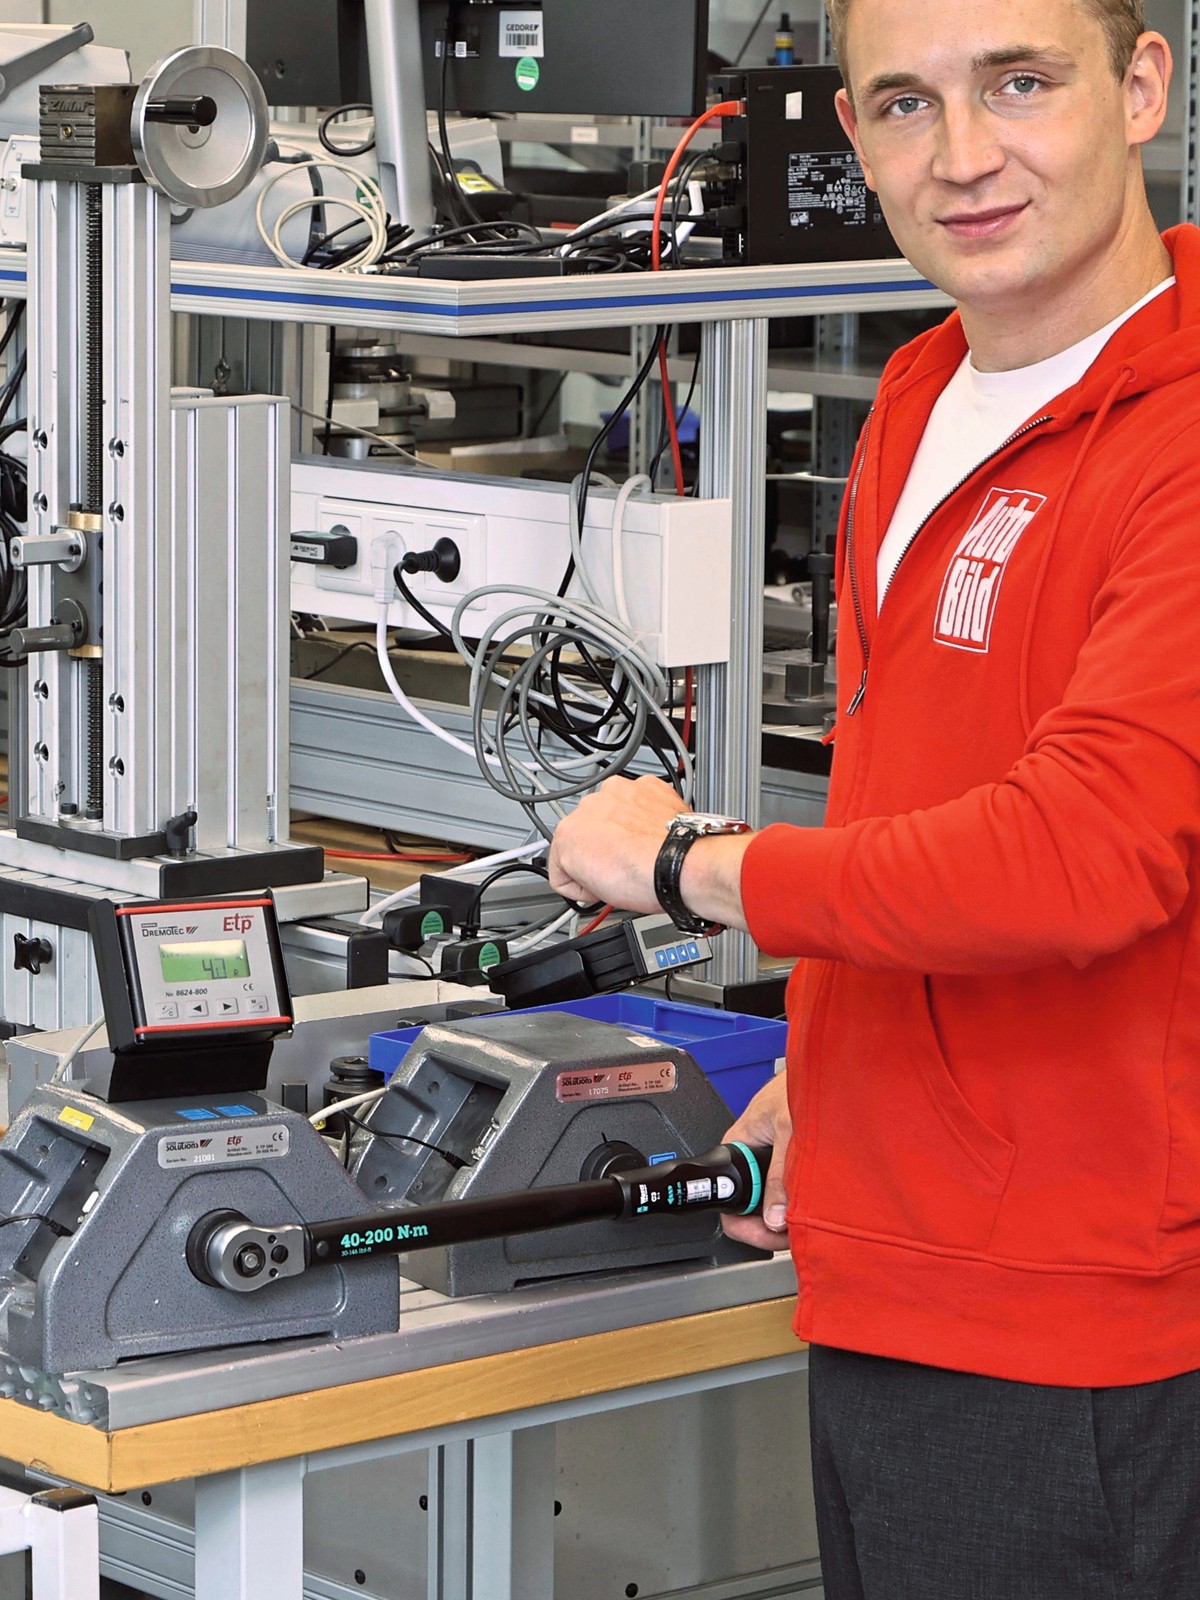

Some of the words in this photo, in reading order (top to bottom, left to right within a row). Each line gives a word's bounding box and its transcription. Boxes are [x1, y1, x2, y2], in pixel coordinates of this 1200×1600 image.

[506, 23, 534, 31] GEDORE
[939, 557, 1001, 642] Bild
[142, 926, 184, 937] DREMOTEC
[176, 988, 208, 997] 8624-800
[660, 1068, 671, 1078] CE
[589, 1087, 609, 1096] 17075
[272, 1132, 283, 1141] CE
[341, 1227, 394, 1248] 40-200
[397, 1224, 429, 1239] N·m
